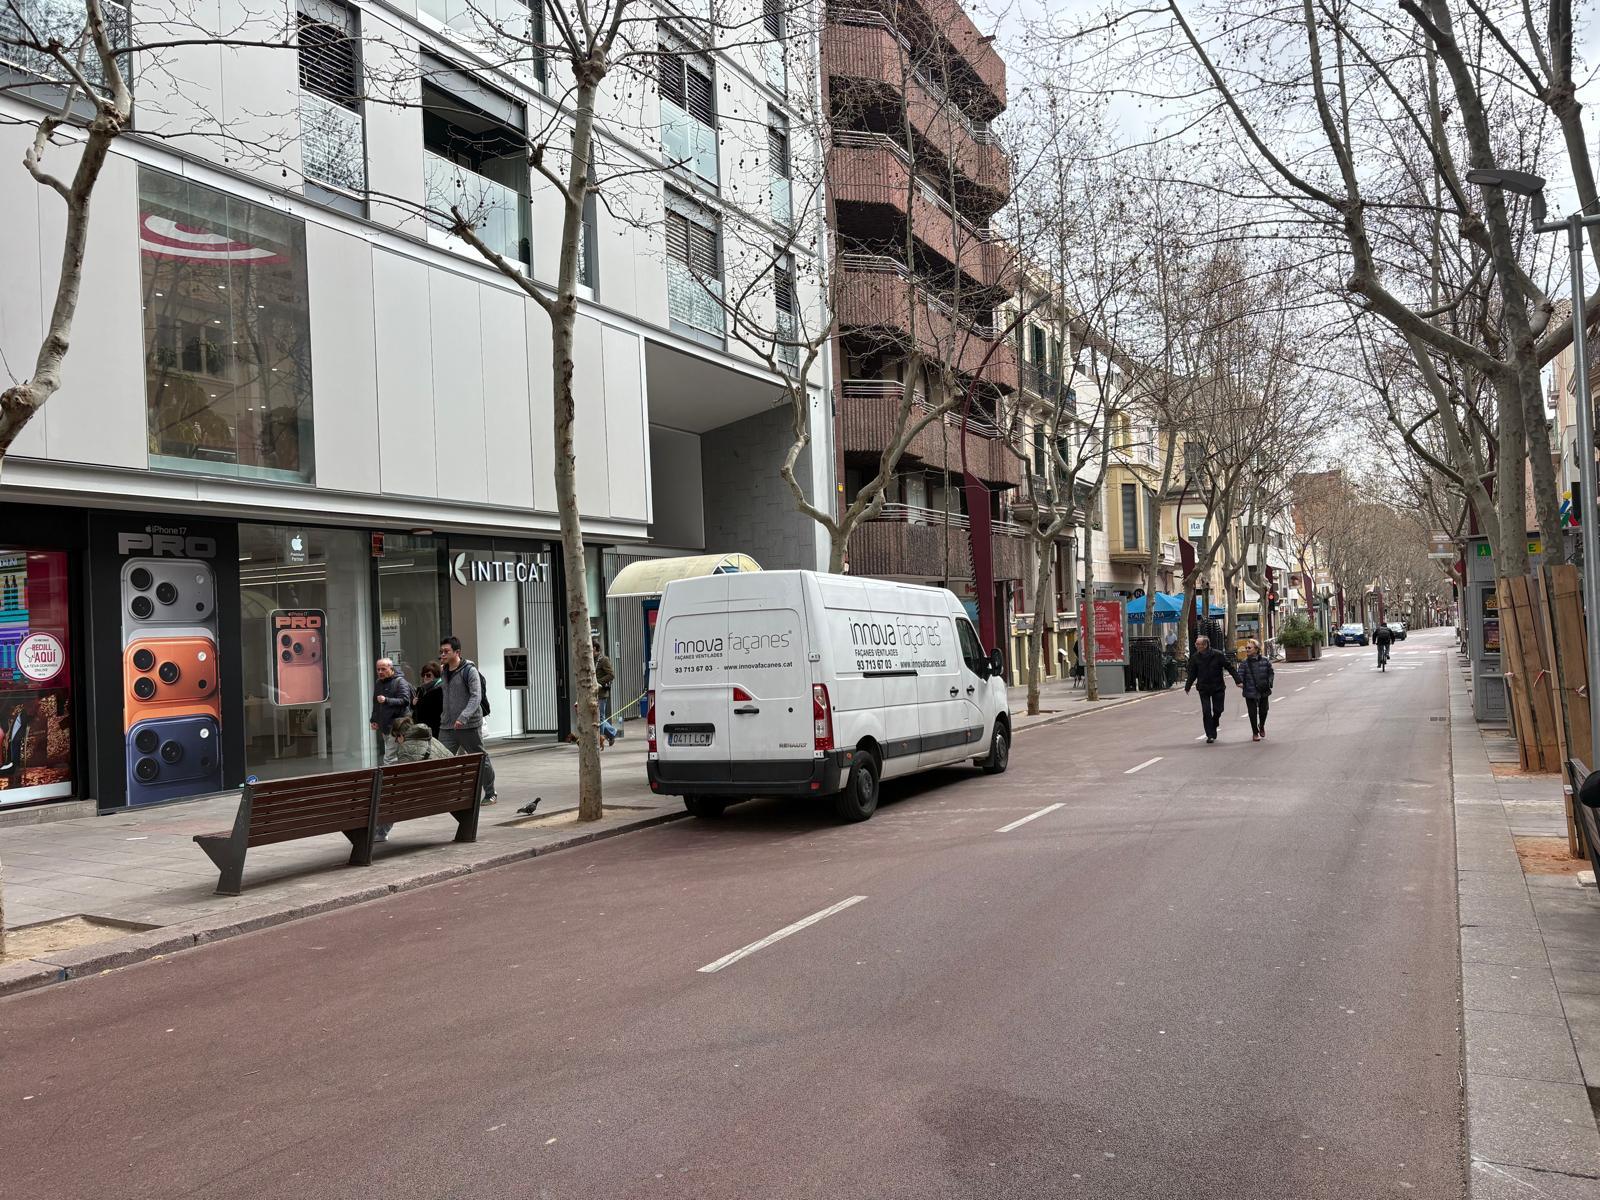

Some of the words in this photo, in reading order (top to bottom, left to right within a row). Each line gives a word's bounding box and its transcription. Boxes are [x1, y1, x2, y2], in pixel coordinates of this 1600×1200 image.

[151, 525, 178, 535] iPhone
[179, 527, 187, 535] 17
[118, 532, 216, 558] PRO
[470, 560, 549, 583] INTECAT
[275, 615, 321, 629] PRO
[849, 617, 897, 645] innova
[896, 617, 941, 653] façanes
[674, 638, 723, 654] innova
[727, 632, 790, 654] façanes
[34, 649, 56, 663] AQUÍ
[674, 653, 695, 661] FAÇANES
[854, 649, 874, 658] FAÇANES
[875, 649, 898, 657] VENTILADES
[723, 661, 793, 671] www.innovafacanes.cat
[856, 660, 865, 670] 93
[865, 660, 876, 670] 713
[877, 660, 884, 669] 67
[885, 659, 892, 669] 03
[900, 659, 947, 668] www.innovafacanes.cat
[673, 734, 692, 743] 0411
